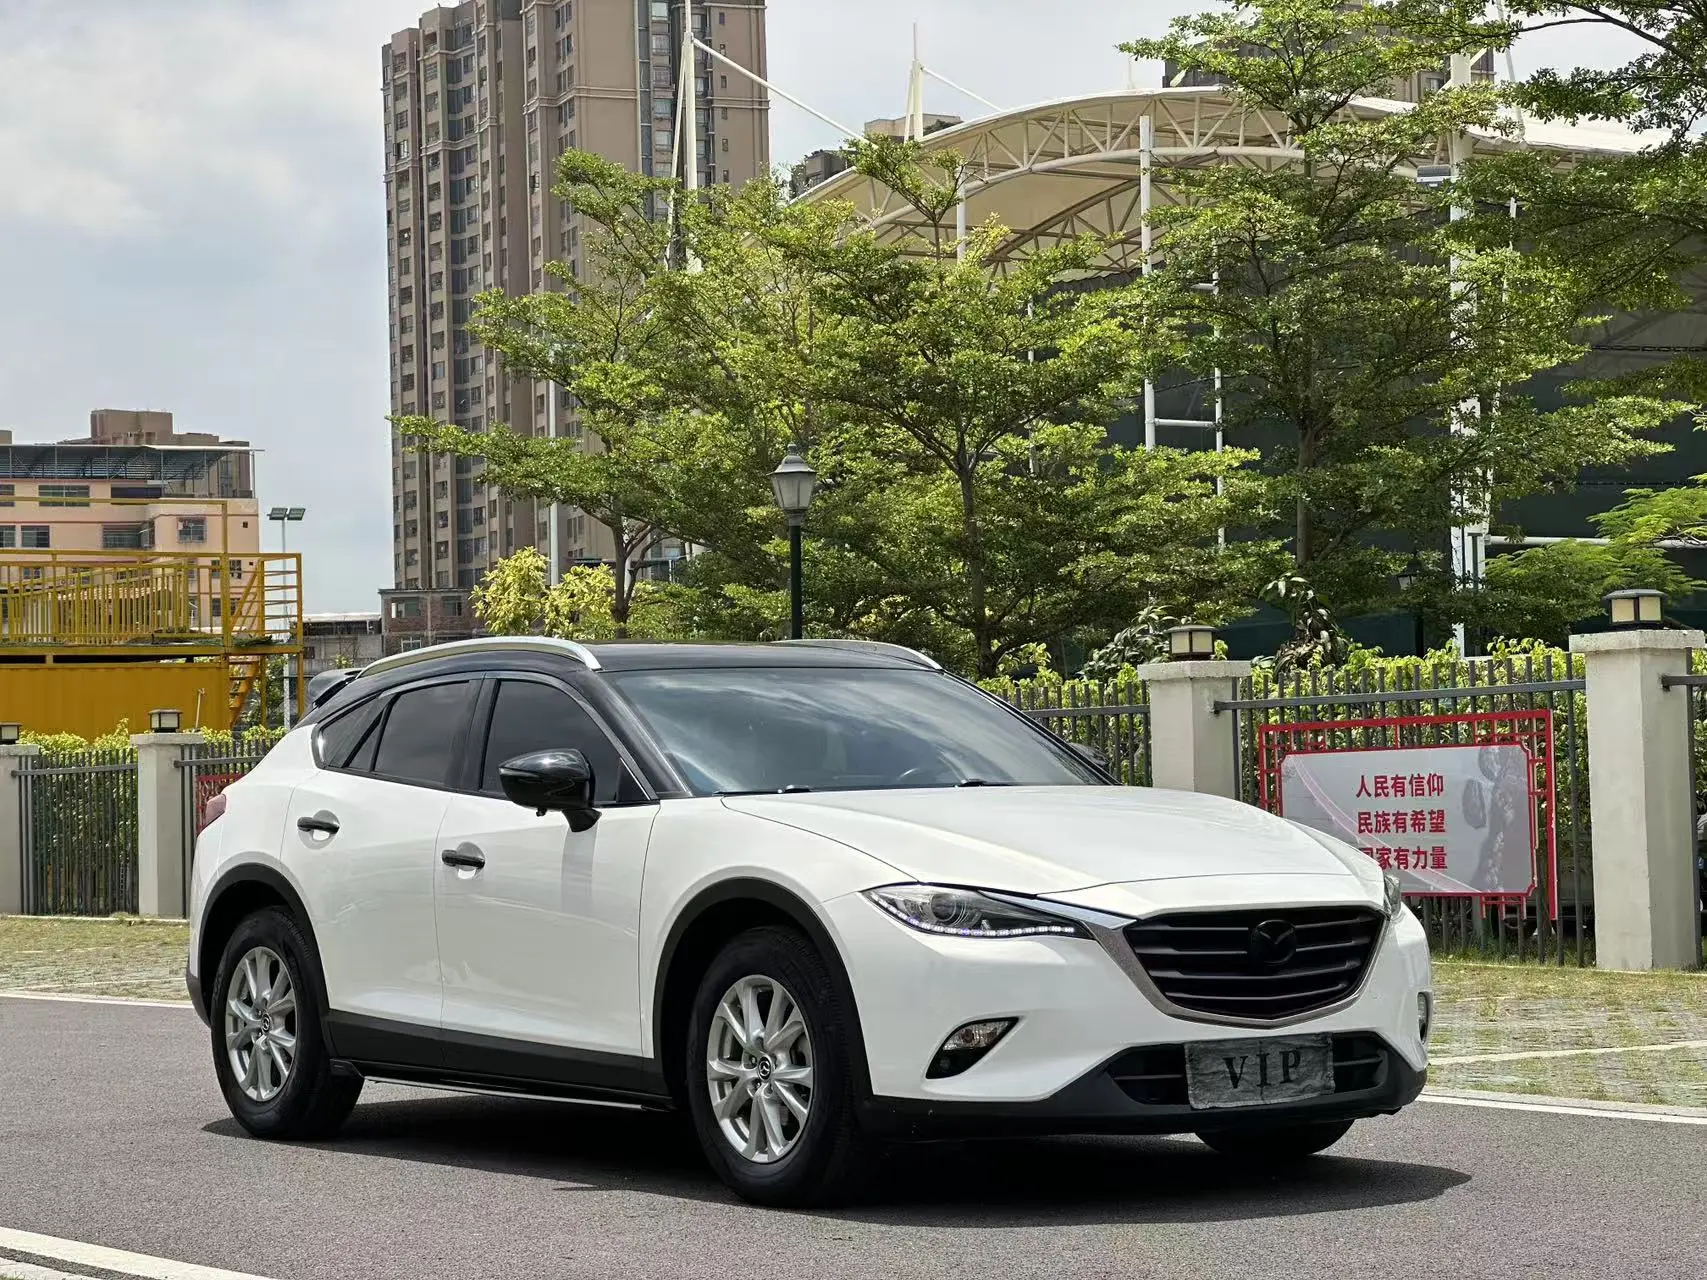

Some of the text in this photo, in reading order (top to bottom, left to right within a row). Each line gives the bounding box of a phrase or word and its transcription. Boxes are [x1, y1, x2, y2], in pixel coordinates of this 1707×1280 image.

[1356, 773, 1444, 798] 人民有信仰
[1357, 809, 1445, 833] 民族有希望
[1222, 1050, 1300, 1089] VIP
